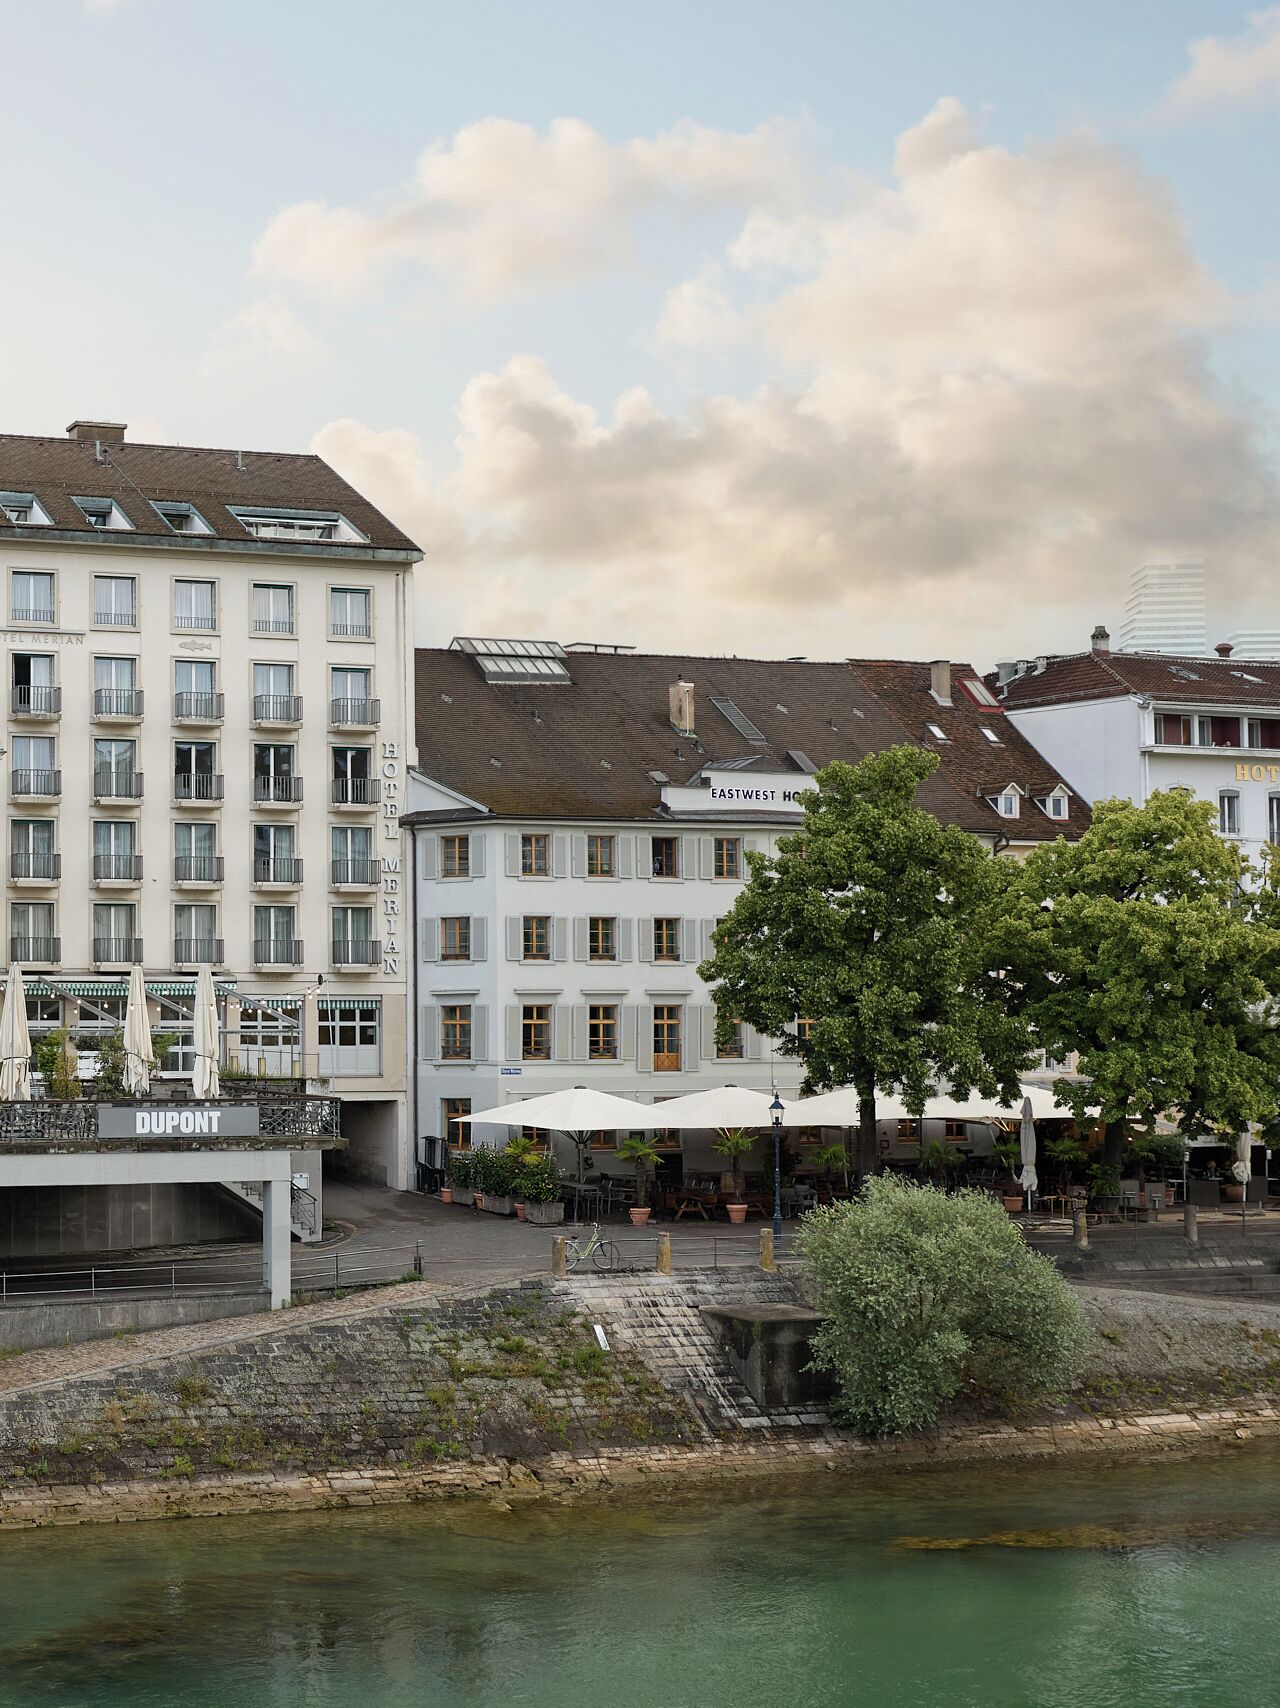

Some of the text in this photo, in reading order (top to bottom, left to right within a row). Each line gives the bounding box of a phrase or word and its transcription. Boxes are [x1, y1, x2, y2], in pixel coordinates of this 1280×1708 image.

[31, 634, 84, 645] MERIAN
[711, 788, 776, 801] EASTWEST
[382, 742, 401, 975] HOTEL MERIAN
[136, 1111, 221, 1134] DUPONT
